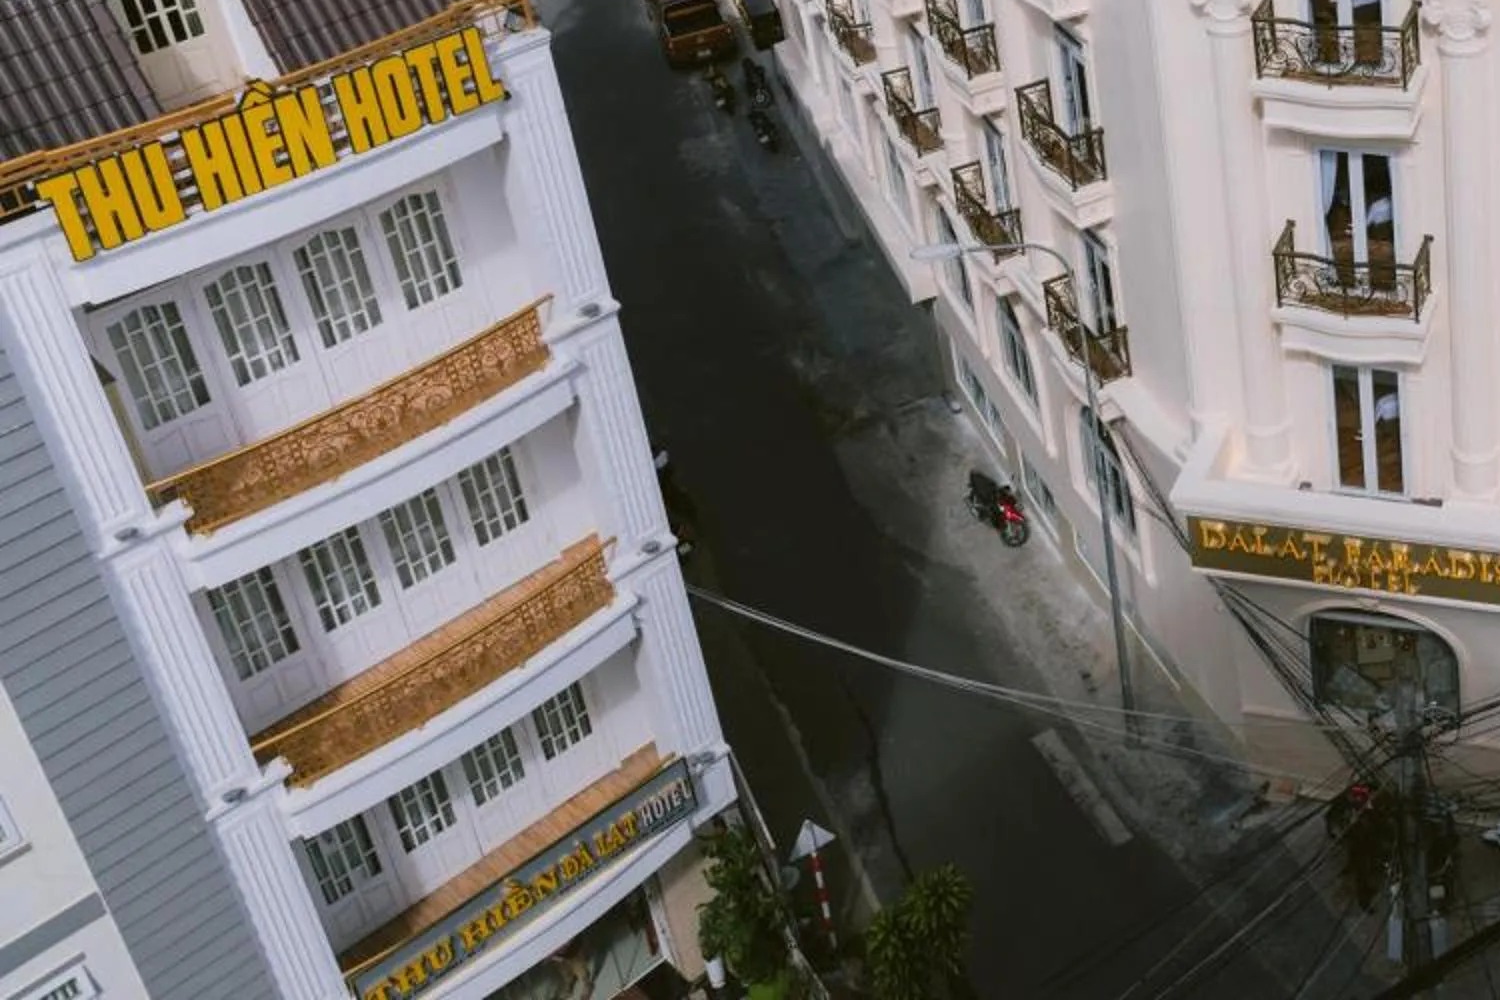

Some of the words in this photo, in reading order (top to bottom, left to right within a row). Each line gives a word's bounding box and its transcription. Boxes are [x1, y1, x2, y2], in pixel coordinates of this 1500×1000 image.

[35, 141, 187, 262] THU
[333, 25, 505, 154] HOTEL
[1200, 519, 1332, 562] DALAT
[1312, 558, 1421, 596] HOTEL
[363, 937, 454, 1000] THU
[638, 777, 693, 828] HOTEL
